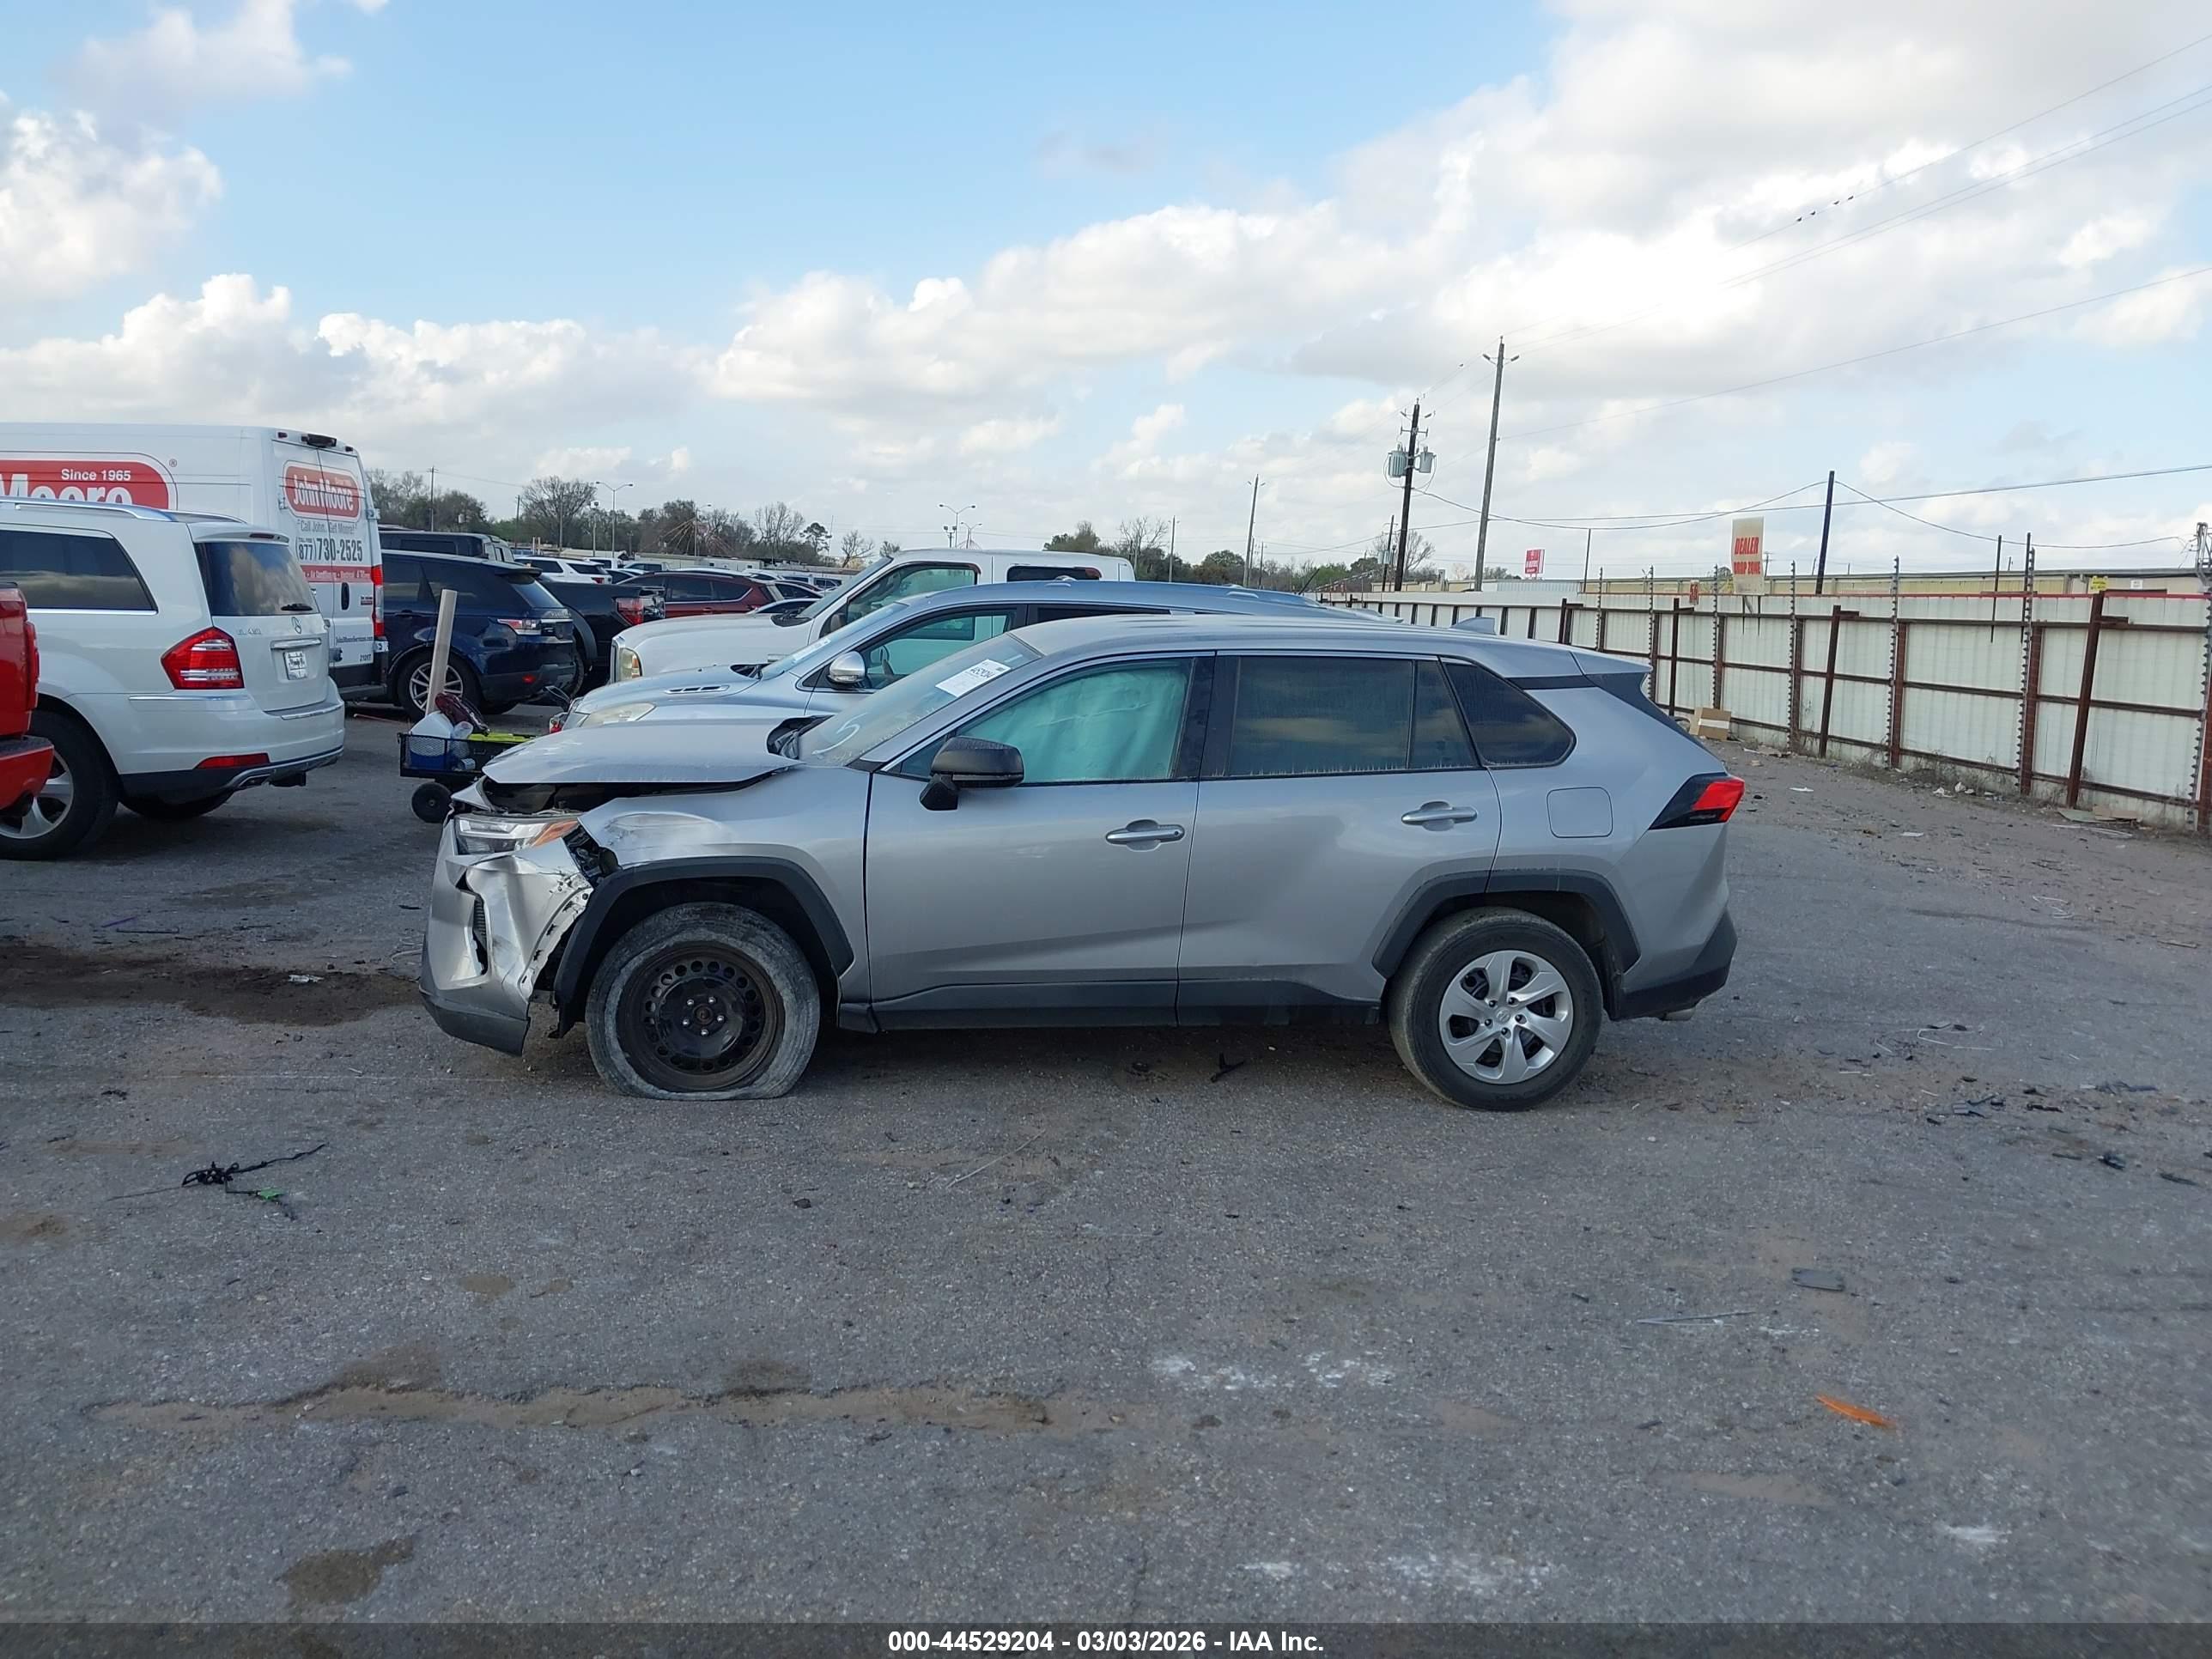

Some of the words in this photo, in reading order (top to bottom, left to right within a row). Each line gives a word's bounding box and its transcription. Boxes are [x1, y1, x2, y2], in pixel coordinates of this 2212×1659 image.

[61, 468, 97, 481] Since
[101, 470, 131, 482] 1965
[1735, 537, 1759, 555] DEALER
